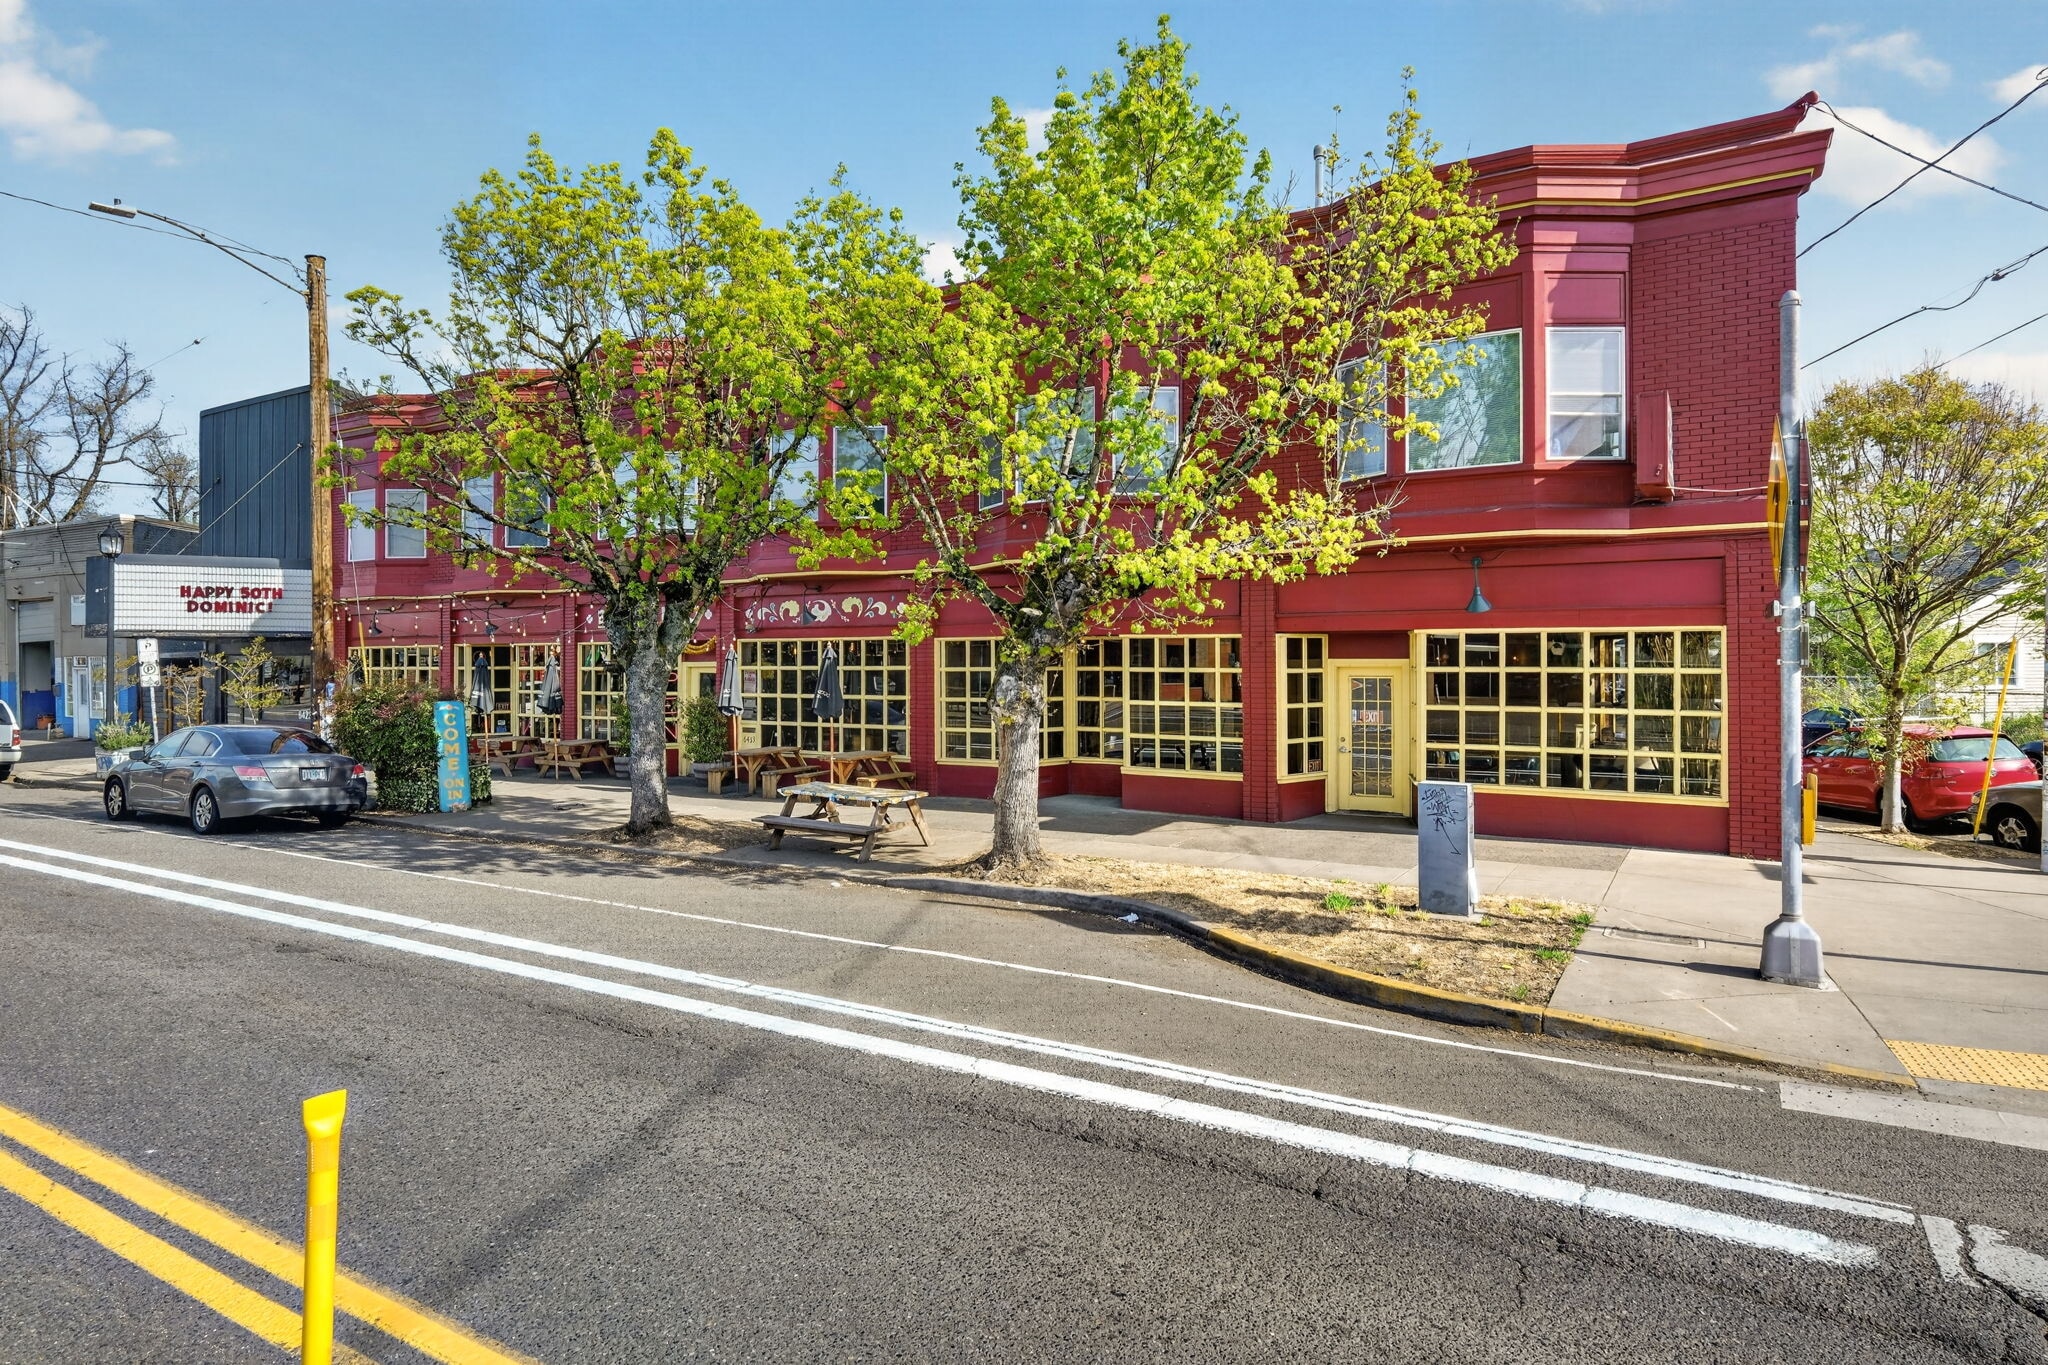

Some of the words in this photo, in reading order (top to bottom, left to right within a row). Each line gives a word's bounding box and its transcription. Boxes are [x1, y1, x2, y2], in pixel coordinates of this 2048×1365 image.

[180, 585, 234, 599] HAPPY
[240, 586, 283, 600] 50TH
[186, 600, 273, 613] DOMINIC!
[443, 713, 461, 771] COME
[444, 778, 465, 789] ON
[447, 790, 463, 800] IN
